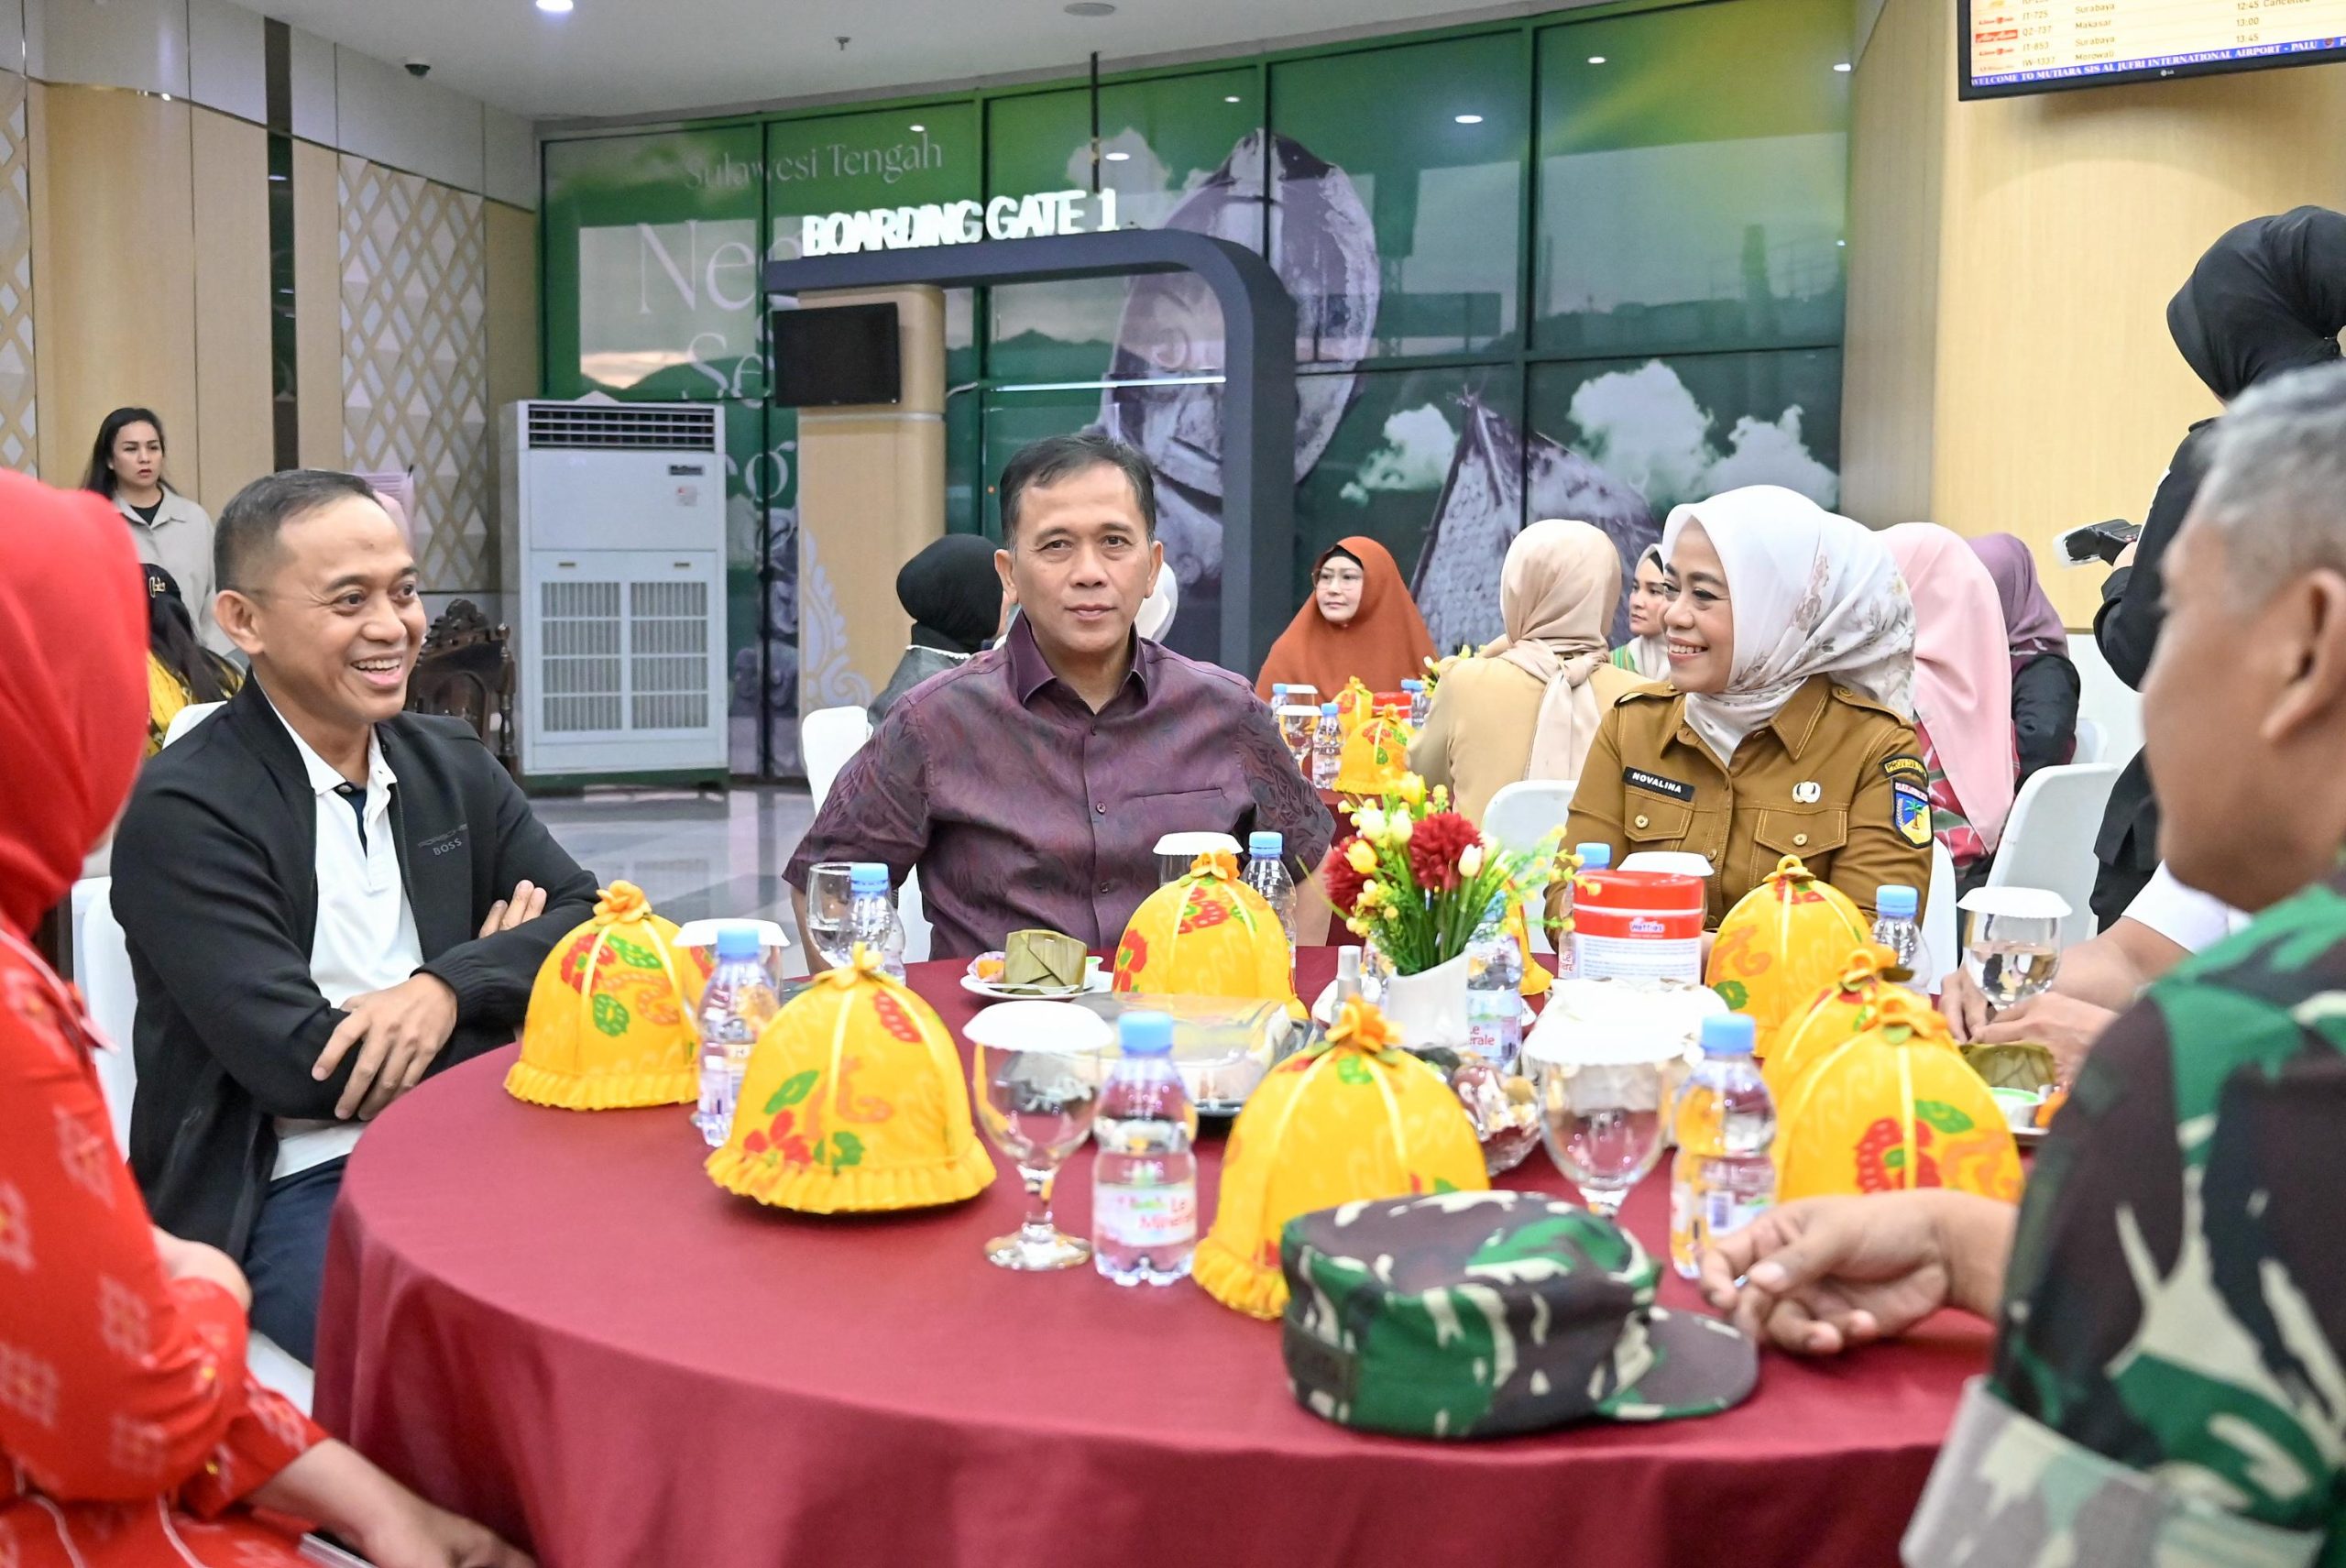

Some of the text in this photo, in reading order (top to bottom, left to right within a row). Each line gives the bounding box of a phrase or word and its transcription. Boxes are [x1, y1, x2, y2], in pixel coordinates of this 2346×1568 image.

[2075, 3, 2115, 14] Surabaya
[2075, 19, 2111, 29] Makasar
[2237, 1, 2259, 11] 12:45
[2075, 36, 2115, 47] Surabaya
[2236, 17, 2259, 27] 13:00
[2236, 34, 2259, 43] 13:45
[1971, 73, 2017, 86] WELCOME
[2022, 72, 2035, 81] TO
[2037, 67, 2083, 80] MUTIARA
[2084, 65, 2100, 74] SIS
[2102, 63, 2115, 72] AL
[2118, 59, 2145, 71] JUFRI
[2148, 51, 2232, 67] INTERNATIONAL
[2235, 45, 2281, 58] AIRPORT
[2291, 41, 2318, 51] PALU
[827, 132, 943, 183] Tengah
[802, 188, 1120, 258] BOARDING GATE 1
[1632, 772, 1682, 794] NOVALINA
[433, 838, 462, 856] BOSS
